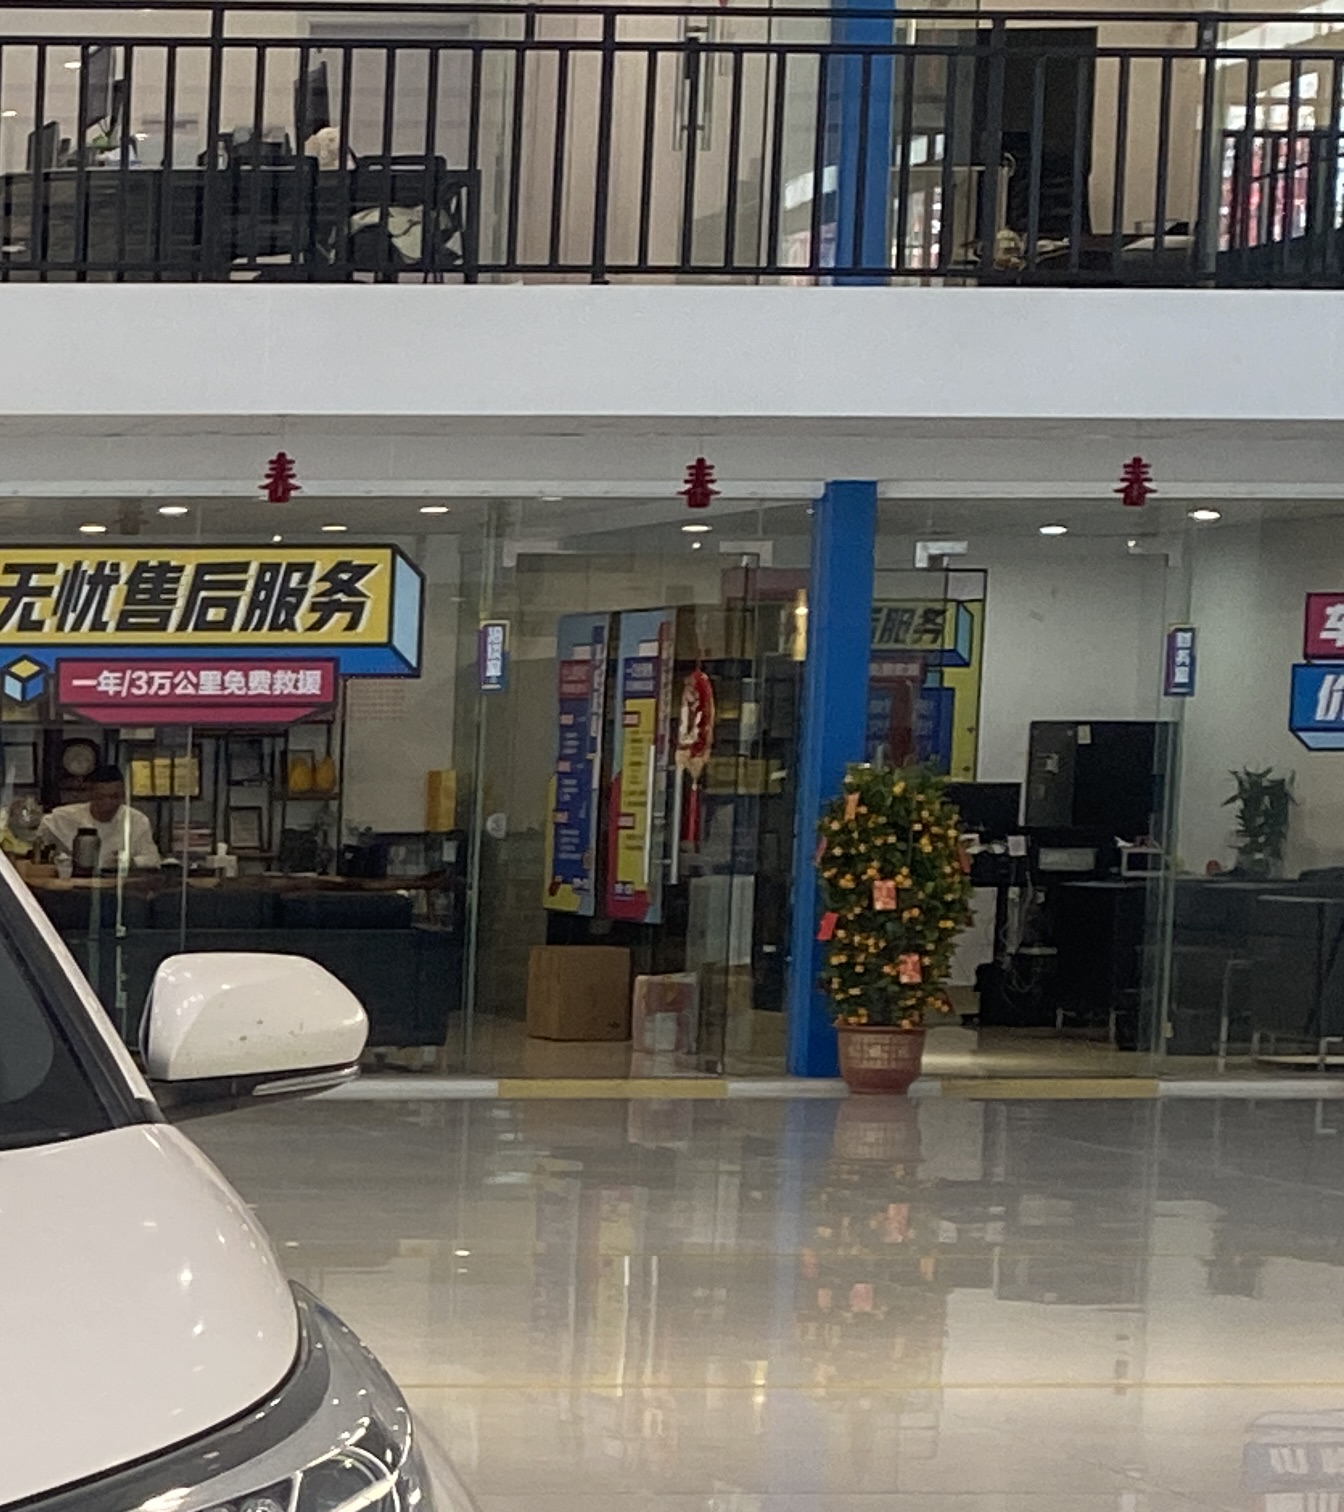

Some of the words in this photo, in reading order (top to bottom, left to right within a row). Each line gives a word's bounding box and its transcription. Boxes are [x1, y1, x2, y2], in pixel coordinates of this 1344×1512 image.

[71, 670, 322, 698] 一年/3万公里免费救援
